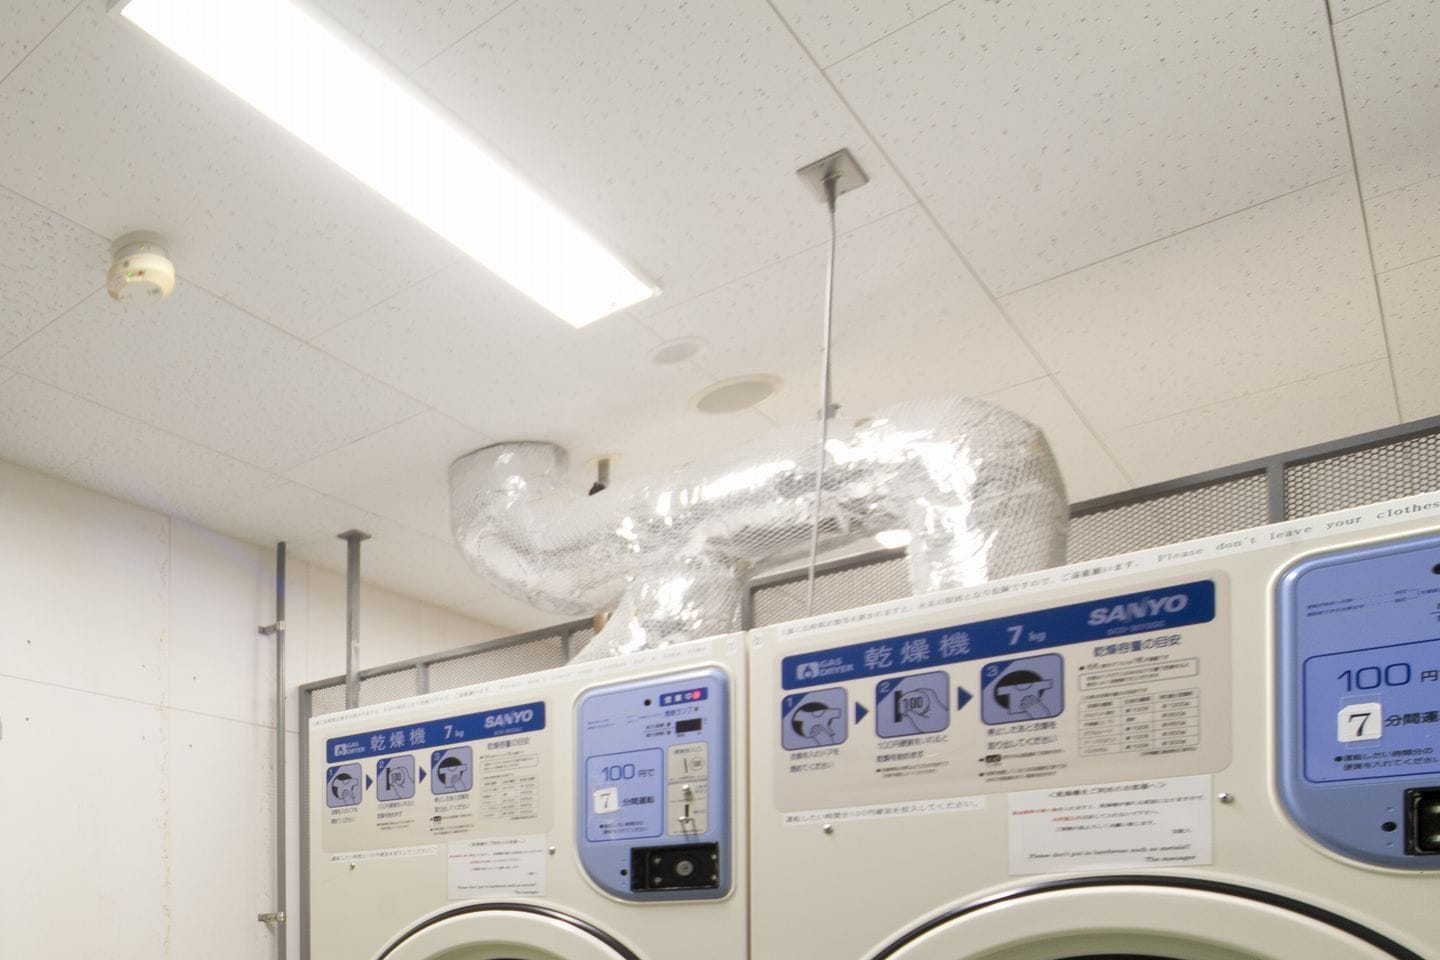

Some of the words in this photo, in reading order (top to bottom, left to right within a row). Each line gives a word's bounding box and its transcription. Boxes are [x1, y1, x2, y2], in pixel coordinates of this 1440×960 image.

[1157, 546, 1204, 563] Please
[1216, 535, 1256, 551] don't
[1270, 526, 1312, 542] leave
[1327, 516, 1362, 530] your
[1087, 594, 1189, 626] SANYO
[864, 632, 970, 670] 乾燥機
[1006, 625, 1025, 647] 7
[1028, 630, 1046, 643] kg
[819, 657, 843, 668] GAS
[1337, 662, 1411, 692] 100
[1421, 670, 1440, 683] 円
[484, 709, 534, 729] SANYO
[1348, 712, 1371, 737] 7
[370, 728, 426, 752] 乾燥機
[444, 725, 453, 740] 7
[602, 764, 635, 781] 100
[601, 793, 610, 808] 7
